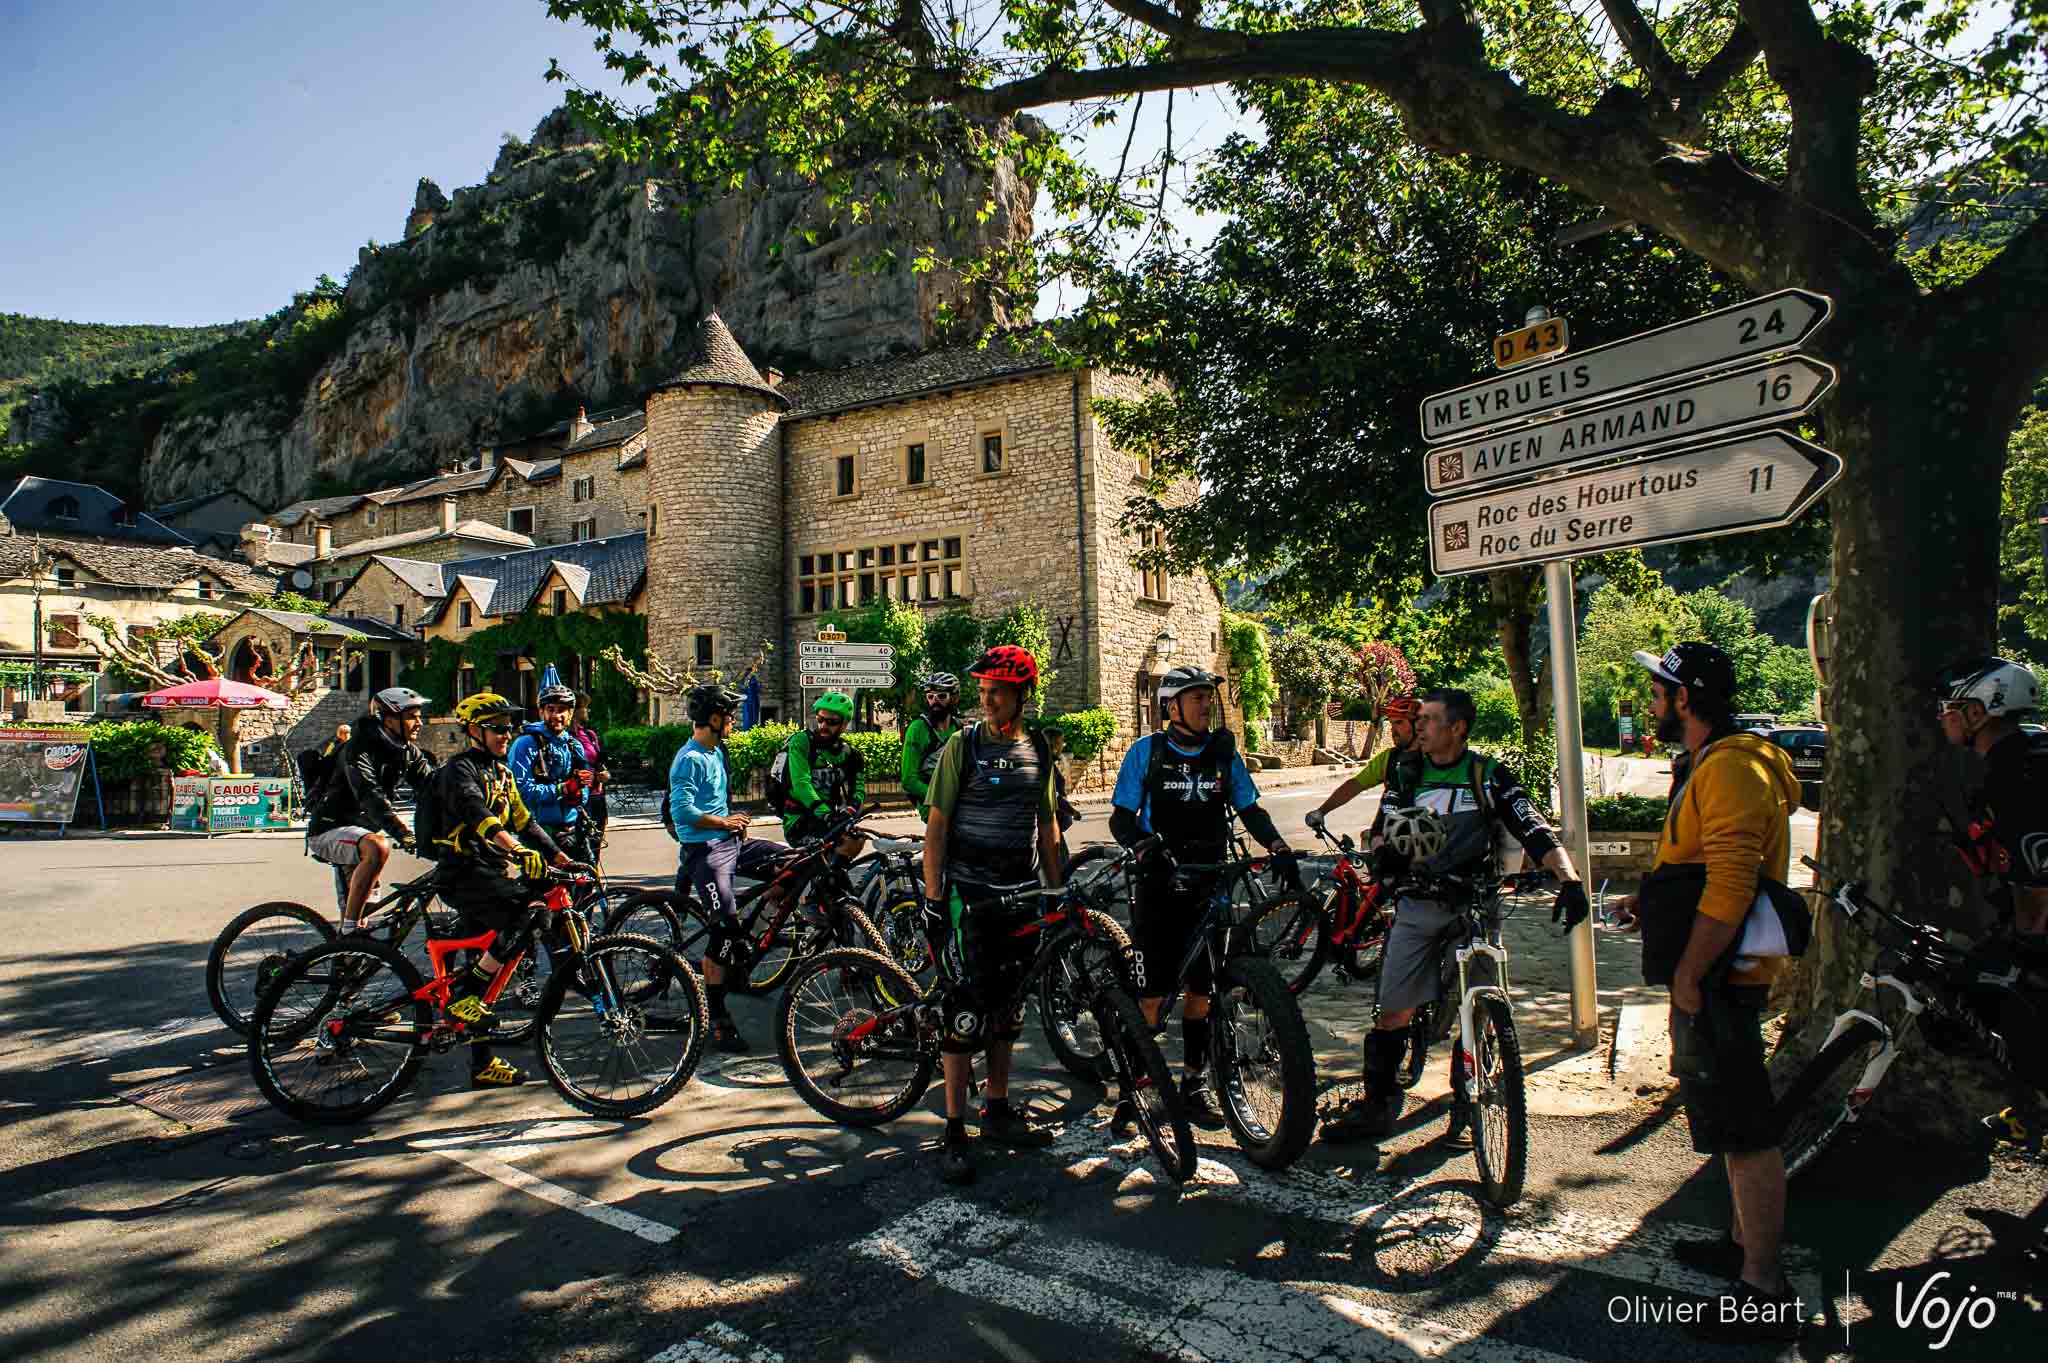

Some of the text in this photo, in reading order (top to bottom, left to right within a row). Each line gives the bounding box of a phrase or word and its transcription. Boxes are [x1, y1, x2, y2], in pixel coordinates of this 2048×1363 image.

[1500, 325, 1560, 362] D 43
[1433, 308, 1785, 428] MEYRUEIS 24
[1472, 373, 1793, 473] AVEN ARMAND 16
[1477, 464, 1775, 529] Roc des Hourtous 11
[1478, 514, 1634, 558] Roc du Serre
[878, 647, 889, 655] 40
[880, 662, 889, 670] 13
[212, 795, 260, 806] 2000
[213, 782, 260, 795] CANOË
